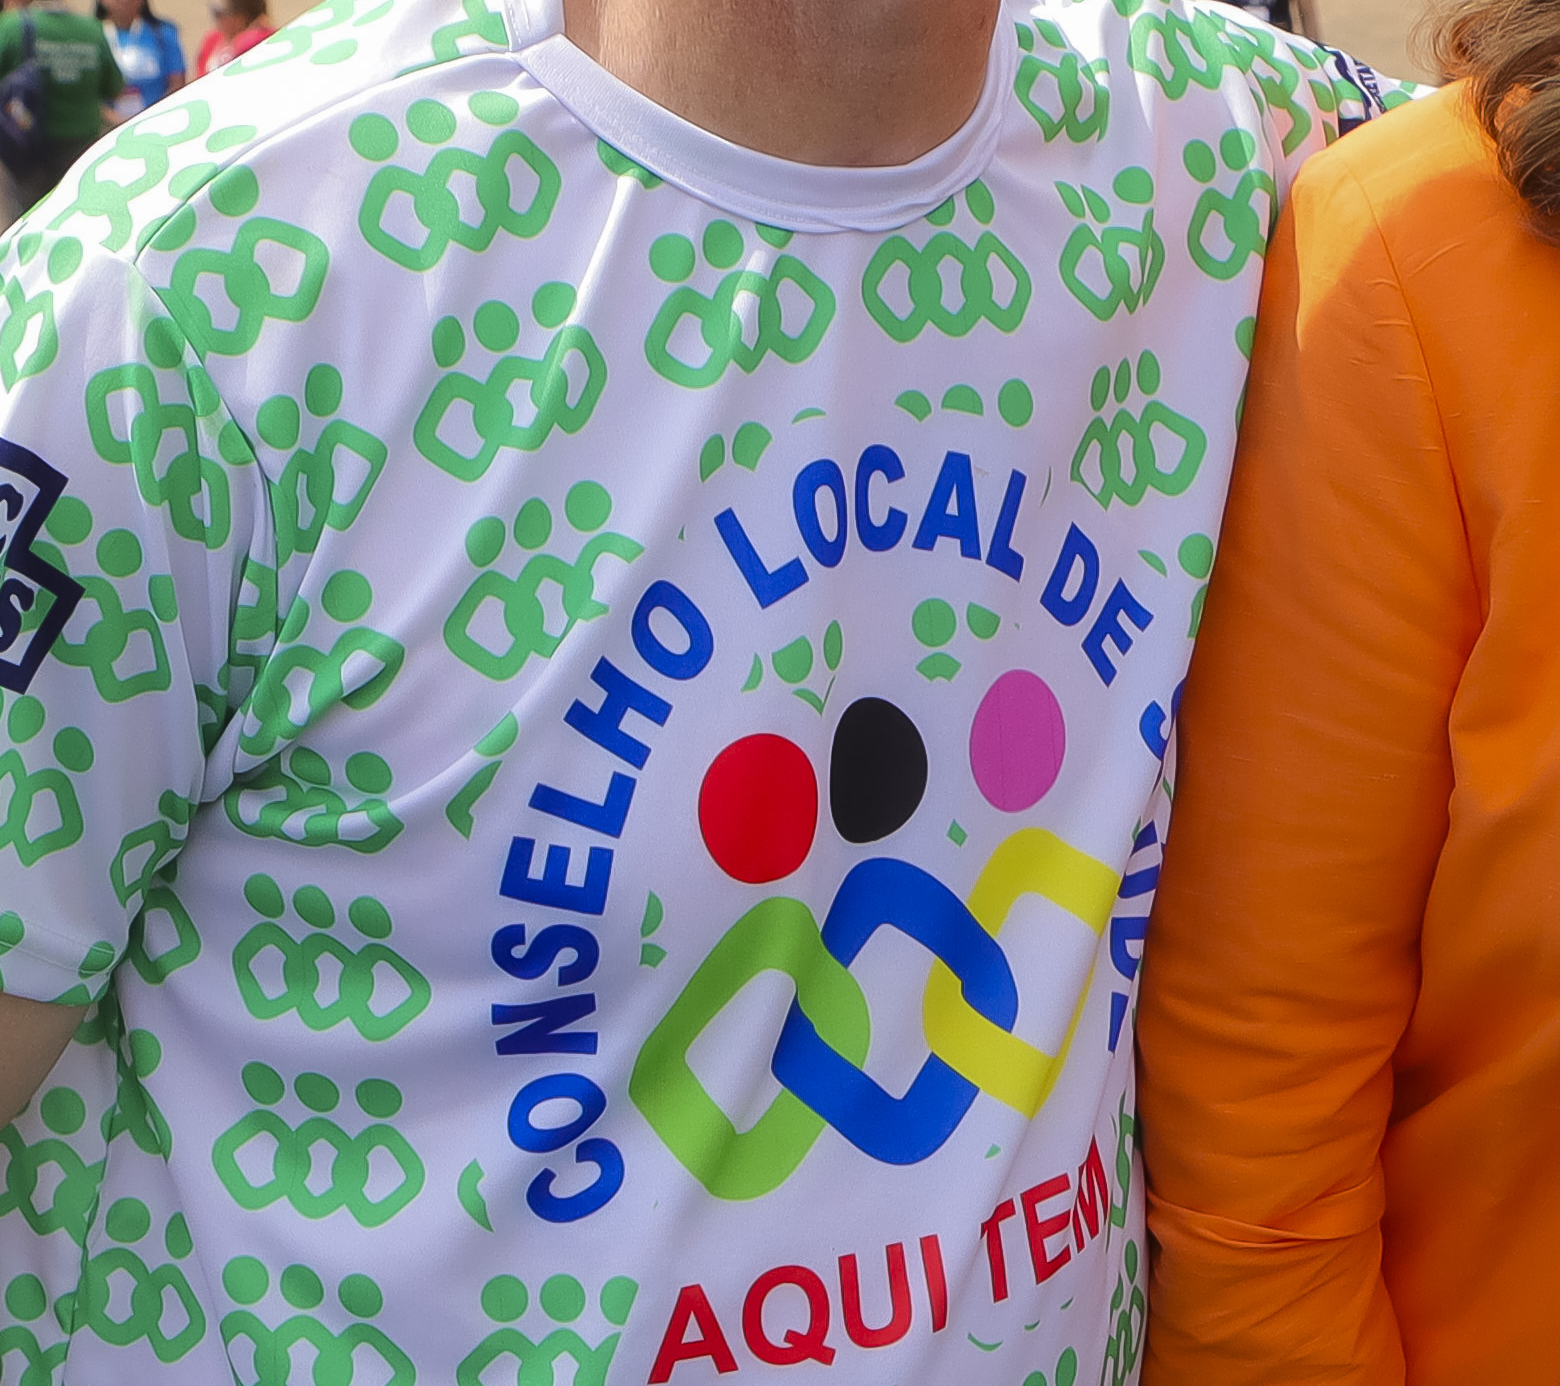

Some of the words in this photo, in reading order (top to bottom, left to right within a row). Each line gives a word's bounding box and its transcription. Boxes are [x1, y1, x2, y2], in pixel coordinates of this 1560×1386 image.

[491, 579, 714, 1223] CONSELHO
[713, 444, 1028, 610] LOCAL
[1039, 522, 1154, 687] DE
[647, 1233, 948, 1385] AQUI
[980, 1133, 1110, 1303] TEM
